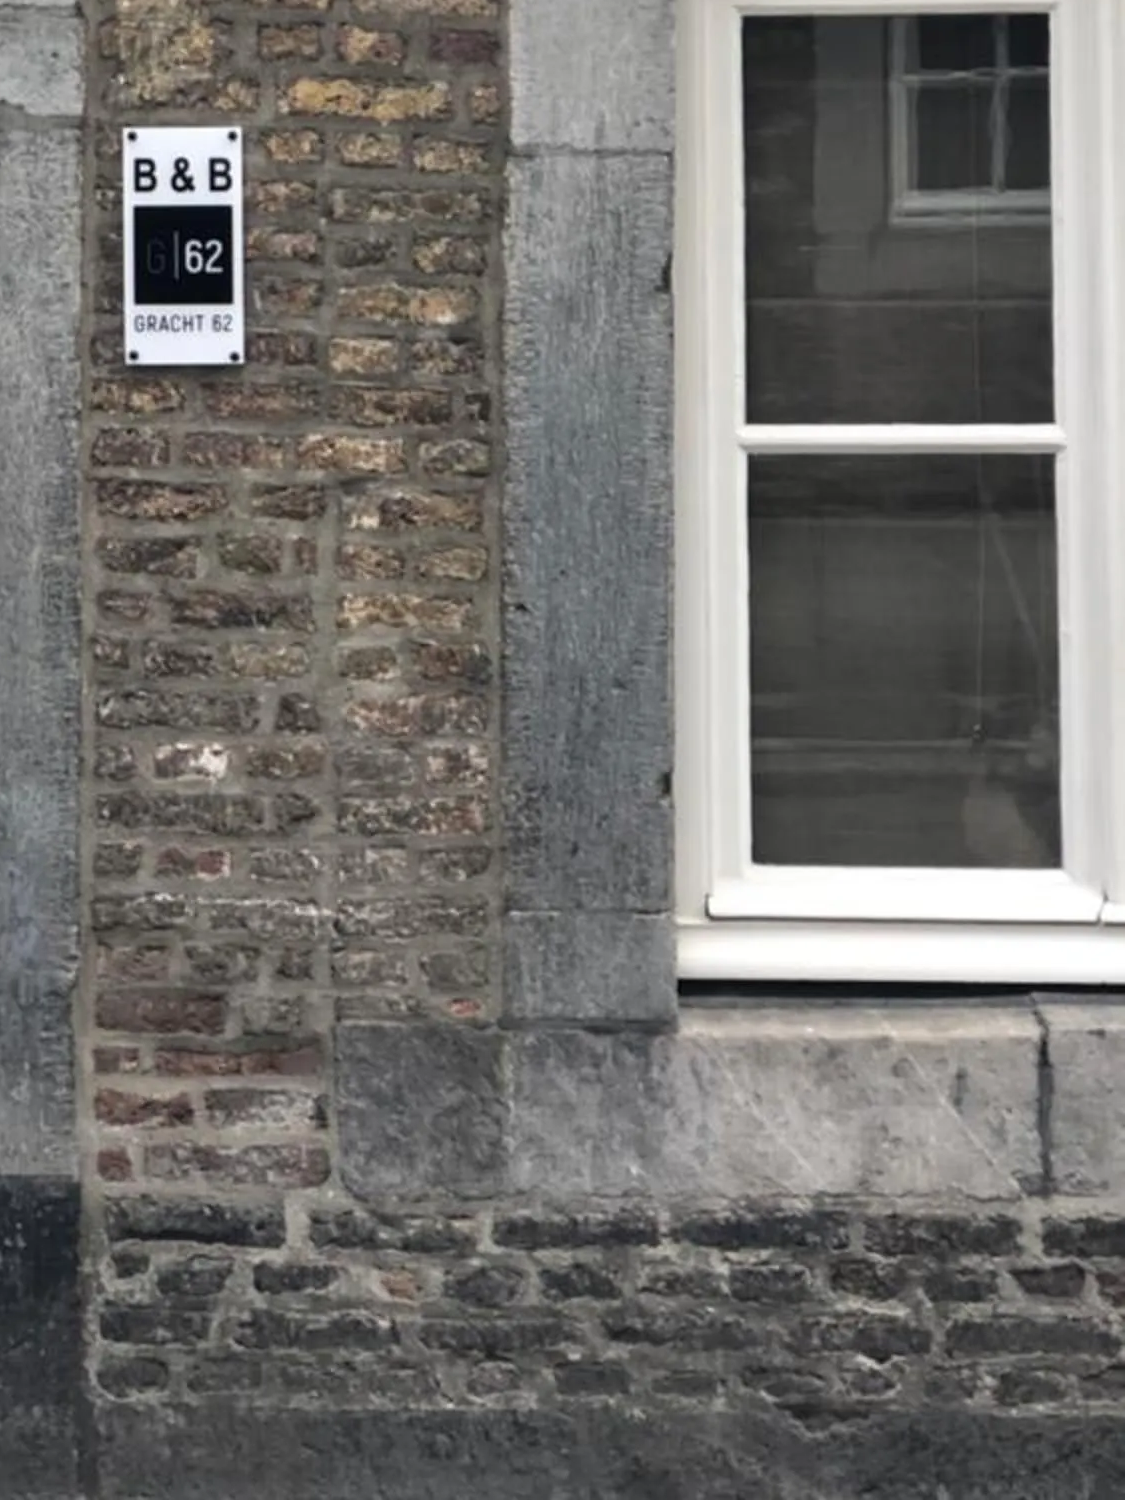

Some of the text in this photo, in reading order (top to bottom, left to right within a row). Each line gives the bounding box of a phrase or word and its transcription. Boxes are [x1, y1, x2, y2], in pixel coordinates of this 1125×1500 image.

[133, 156, 232, 193] B & B
[183, 239, 224, 274] 62
[133, 314, 233, 333] GRACHT 62
